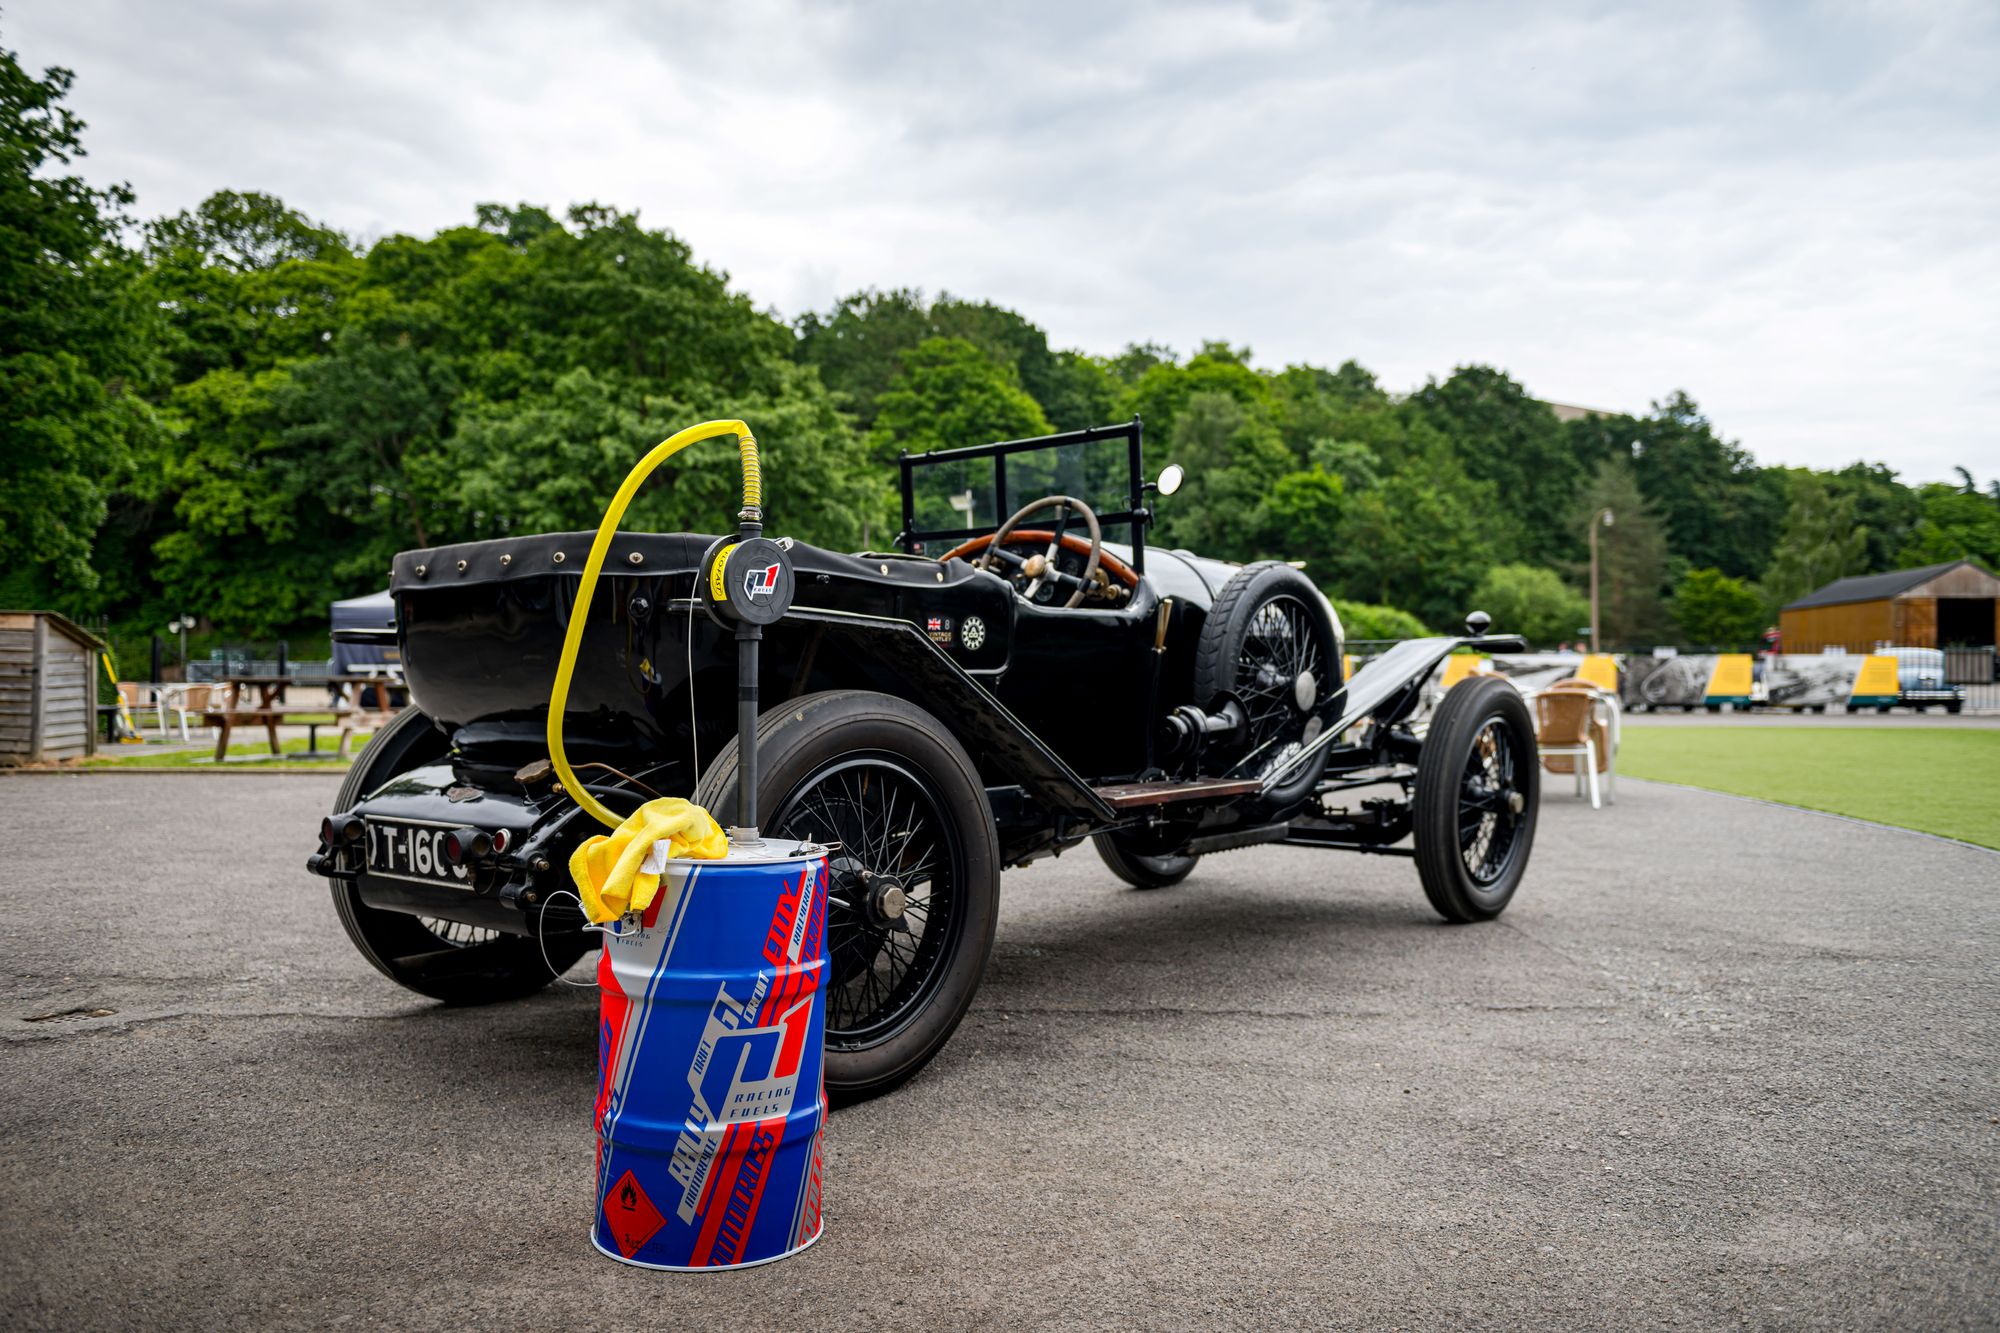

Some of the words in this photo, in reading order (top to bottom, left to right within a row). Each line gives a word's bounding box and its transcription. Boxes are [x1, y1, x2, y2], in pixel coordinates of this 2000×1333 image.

[743, 970, 770, 1024] CIRCUIT
[693, 1040, 711, 1075] DRIFT
[730, 1103, 779, 1118] FUELS
[735, 1086, 792, 1103] RACING
[668, 1100, 709, 1188] RALLY
[684, 1136, 717, 1208] MOTORCYCLE
